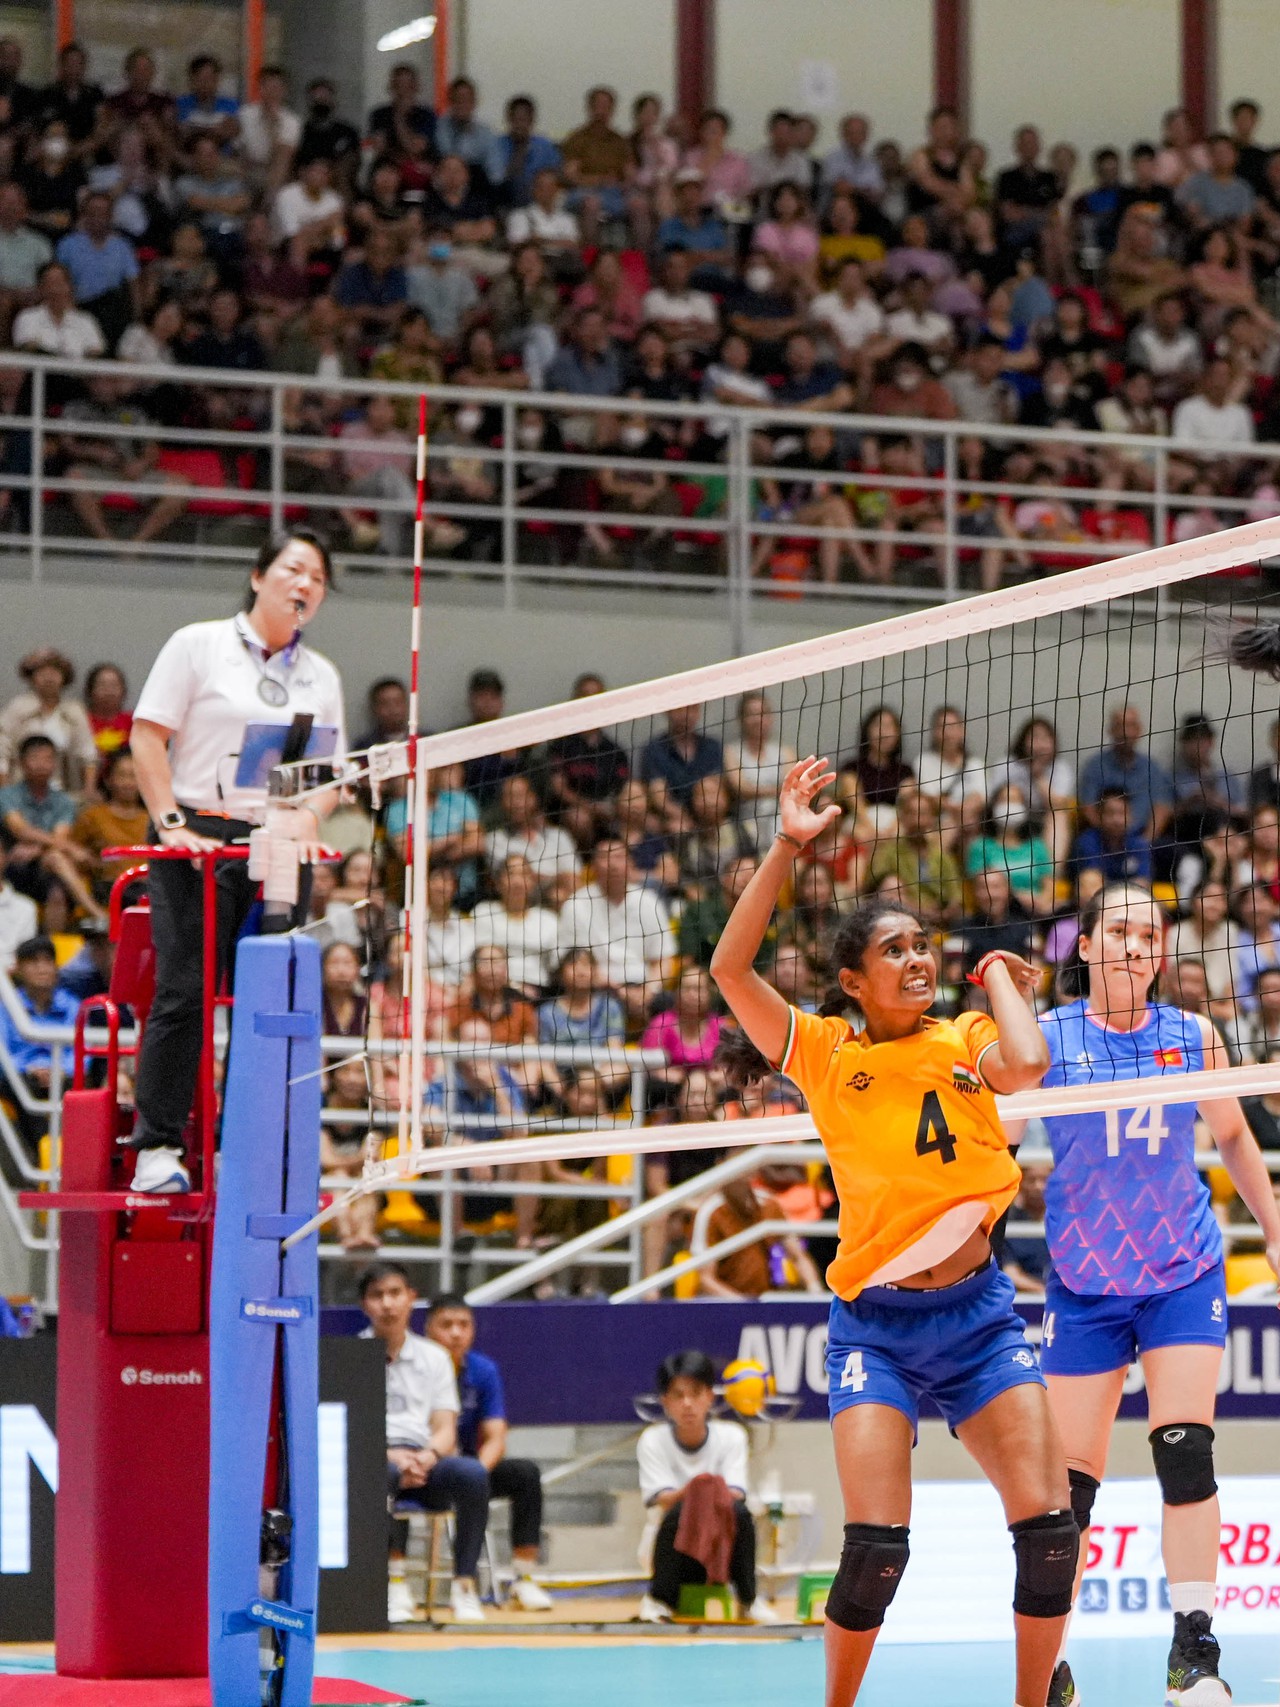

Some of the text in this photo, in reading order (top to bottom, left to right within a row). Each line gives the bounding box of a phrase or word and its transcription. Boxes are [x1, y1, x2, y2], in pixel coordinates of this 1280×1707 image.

[915, 1089, 957, 1165] 4
[1105, 1103, 1169, 1157] 14
[255, 1305, 300, 1319] Senoh
[139, 1369, 203, 1385] Senoh
[840, 1351, 868, 1393] 4
